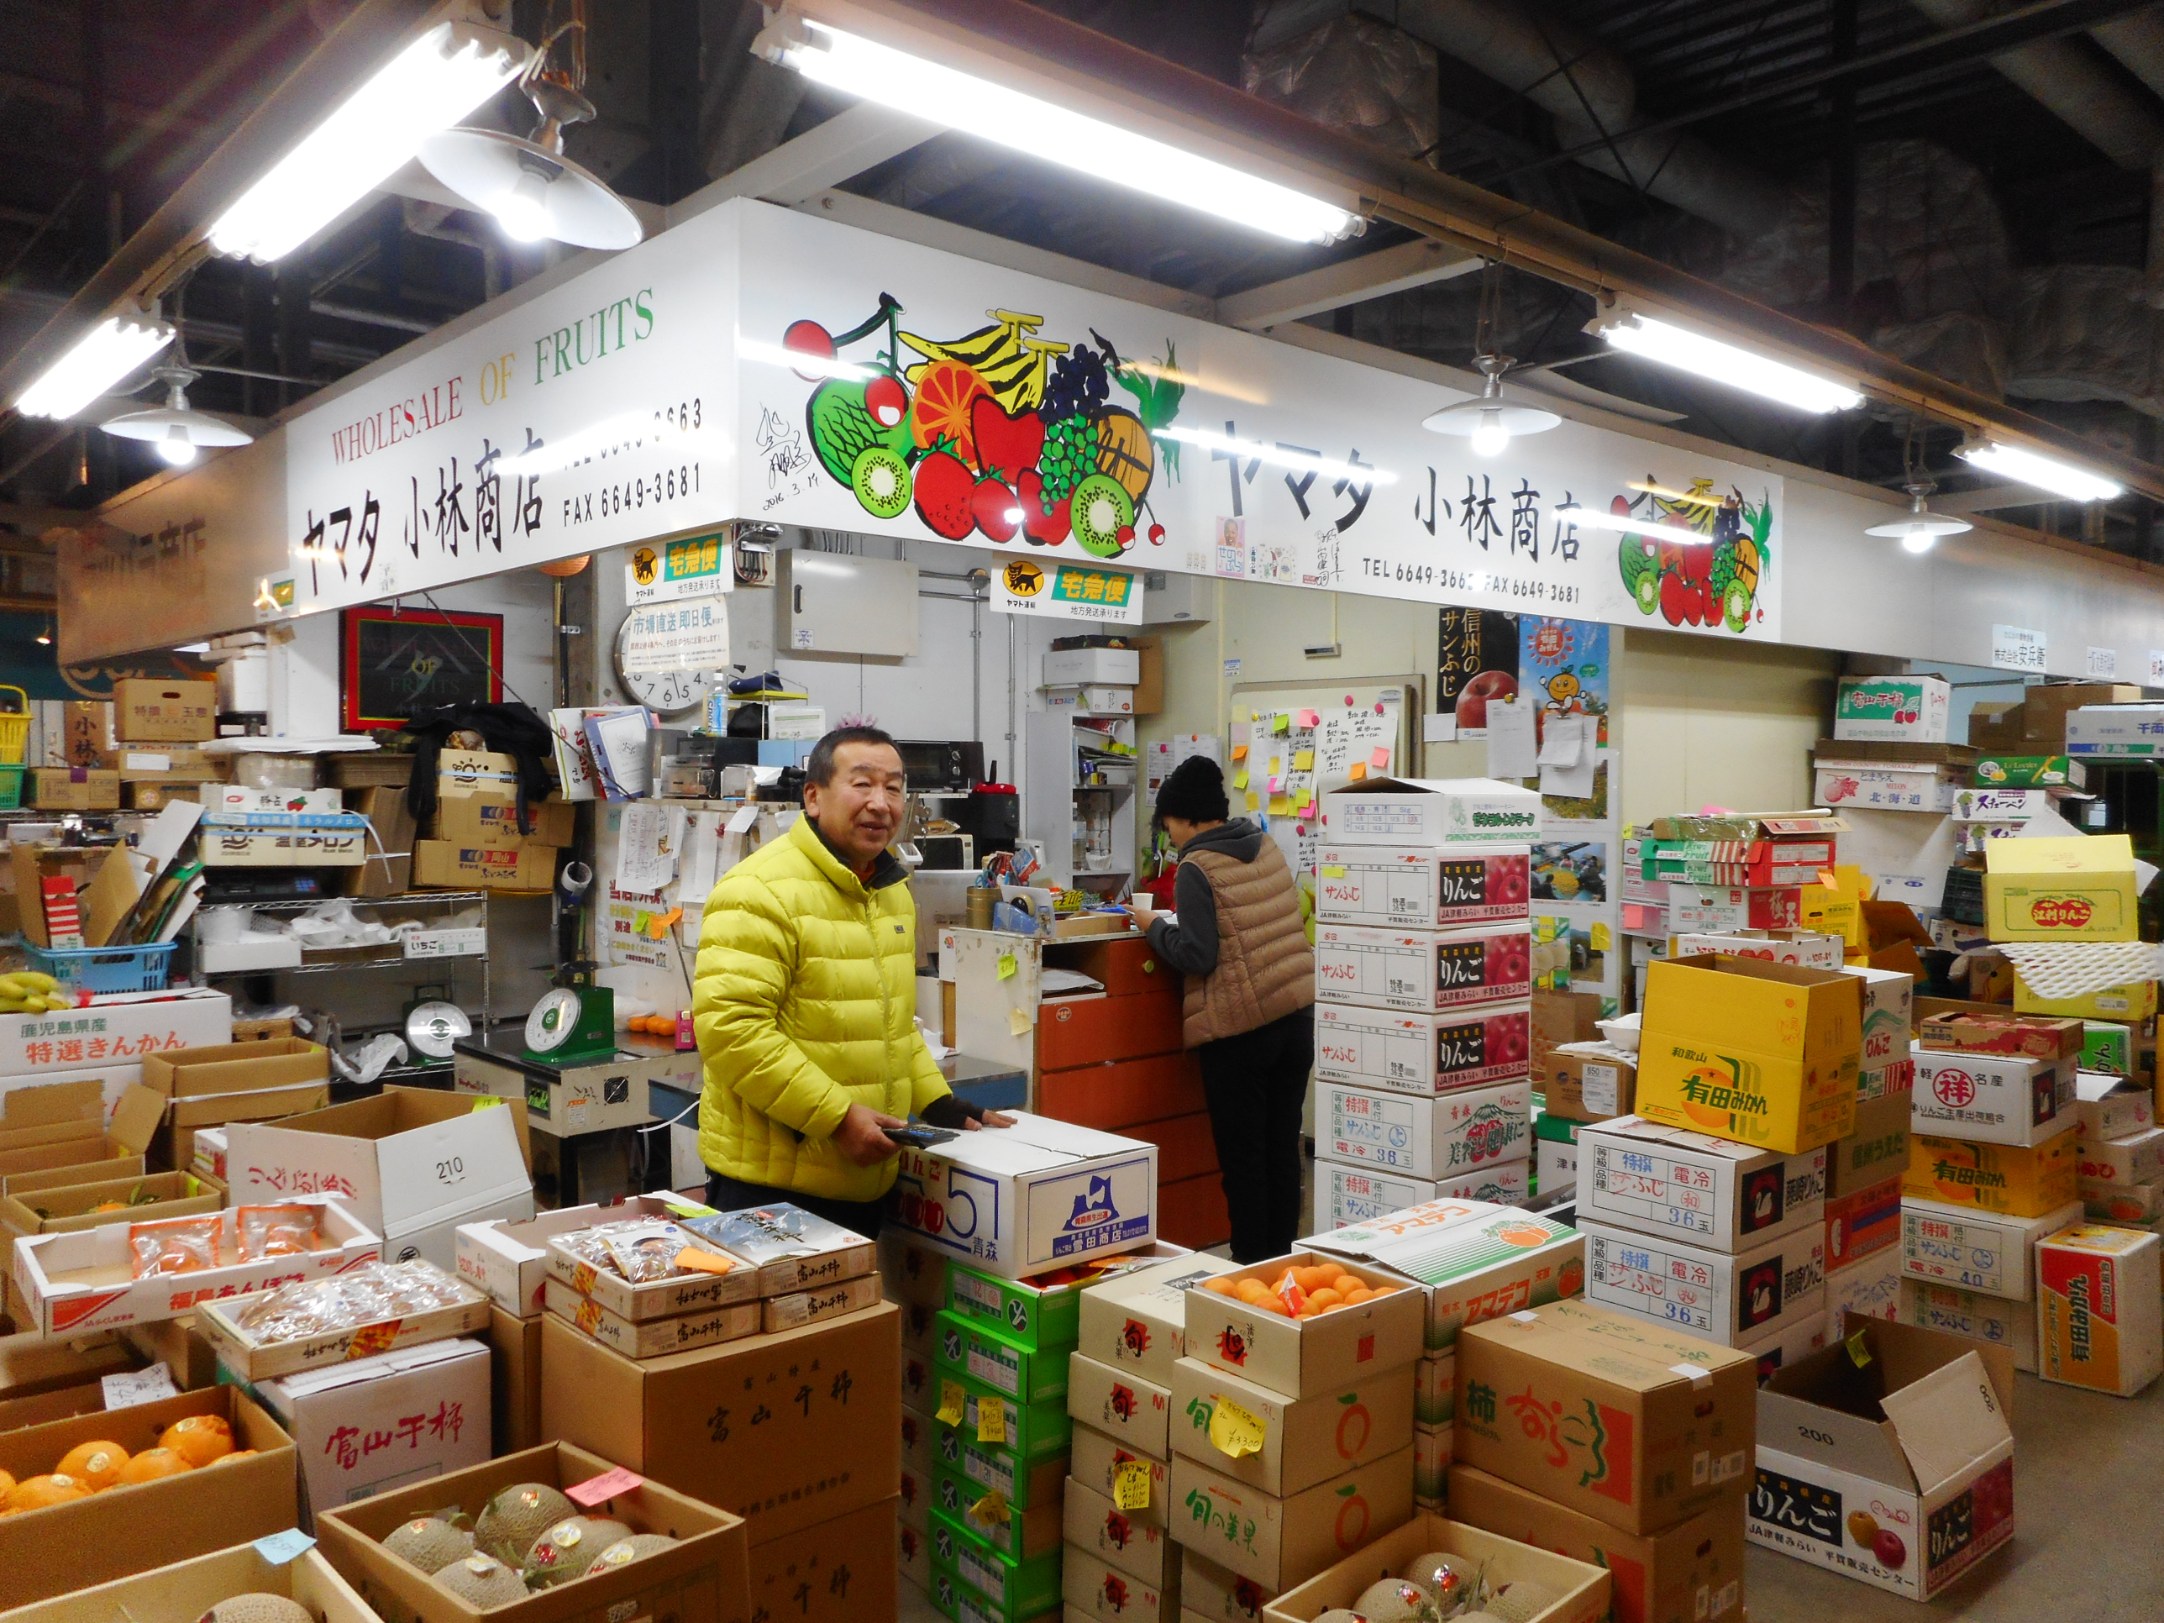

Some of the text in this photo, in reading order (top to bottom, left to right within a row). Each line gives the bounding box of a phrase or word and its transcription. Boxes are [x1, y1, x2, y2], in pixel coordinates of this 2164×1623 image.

[332, 376, 463, 466] WHOLESALE
[479, 352, 516, 406] OF
[534, 288, 654, 386] FRUITS
[563, 462, 700, 527] FAX 6649-3681
[1212, 420, 1376, 534] ヤマタ
[1414, 465, 1582, 564] 小林商店
[303, 488, 380, 597] ヤマタ
[404, 427, 545, 560] 小林商店
[669, 538, 718, 577] 宅急便
[1061, 570, 1127, 605] 宅急便
[1363, 558, 1391, 578] TEL
[1512, 580, 1580, 604] 6649-3681
[1070, 606, 1128, 620] 地方発送承ります
[1461, 608, 1482, 674] 信州の
[1439, 610, 1460, 698] サンふじ
[647, 684, 656, 696] 7
[663, 689, 672, 702] 6
[681, 685, 690, 698] 5
[1683, 849, 1709, 859] Fruit
[1688, 872, 1712, 882] Fruit
[1443, 876, 1484, 901] りんご
[1441, 905, 1527, 919] JA津軽みらい 平賀販売センター
[412, 940, 438, 951] いちご
[1440, 957, 1483, 986] りんご
[1439, 984, 1528, 1002] JA津軽みらい 平賀販売センター
[20, 1017, 107, 1038] 鹿児島県産
[26, 1031, 188, 1065] 特選きんかん
[1440, 1040, 1483, 1068] りんご
[1672, 1046, 1708, 1063] 和歌山
[1865, 1035, 1892, 1057] りんご
[1439, 1063, 1528, 1085] JA津軽みらい 平賀販売センター
[1678, 1075, 1768, 1115] 有田みかん
[1938, 1073, 2004, 1103] 祥 名産
[1345, 1096, 1370, 1115] 特撰
[1919, 1104, 2006, 1123] りんご生産出荷組合
[1376, 1149, 1397, 1165] 36
[1622, 1152, 1653, 1173] 特撰
[436, 1157, 464, 1180] 210
[1595, 1169, 1606, 1190] 品種
[1673, 1165, 1710, 1187] 電冷
[1932, 1159, 2007, 1188] 有田みかん
[1345, 1175, 1370, 1196] 特撰
[1669, 1207, 1695, 1227] 36
[1921, 1220, 1949, 1239] 特撰
[971, 1237, 998, 1263] 青森
[1620, 1249, 1650, 1271] 特撰
[798, 1260, 841, 1284] 富山干柿
[1593, 1261, 1604, 1281] 品種
[1671, 1261, 1708, 1284] 電冷
[808, 1292, 849, 1317] 富山干柿
[1666, 1303, 1691, 1323] 36
[677, 1316, 723, 1344] 富山干柿
[706, 1369, 853, 1443] 富山干柿
[1152, 1392, 1165, 1411] M
[1467, 1379, 1497, 1424] 柿
[325, 1402, 465, 1471] 富山干柿
[1797, 1425, 1834, 1447] 200
[1151, 1462, 1164, 1482] M
[1756, 1484, 1837, 1536] りんご
[1749, 1525, 1817, 1555] JA津軽みらい
[1825, 1551, 1916, 1587] 平賀販売センター
